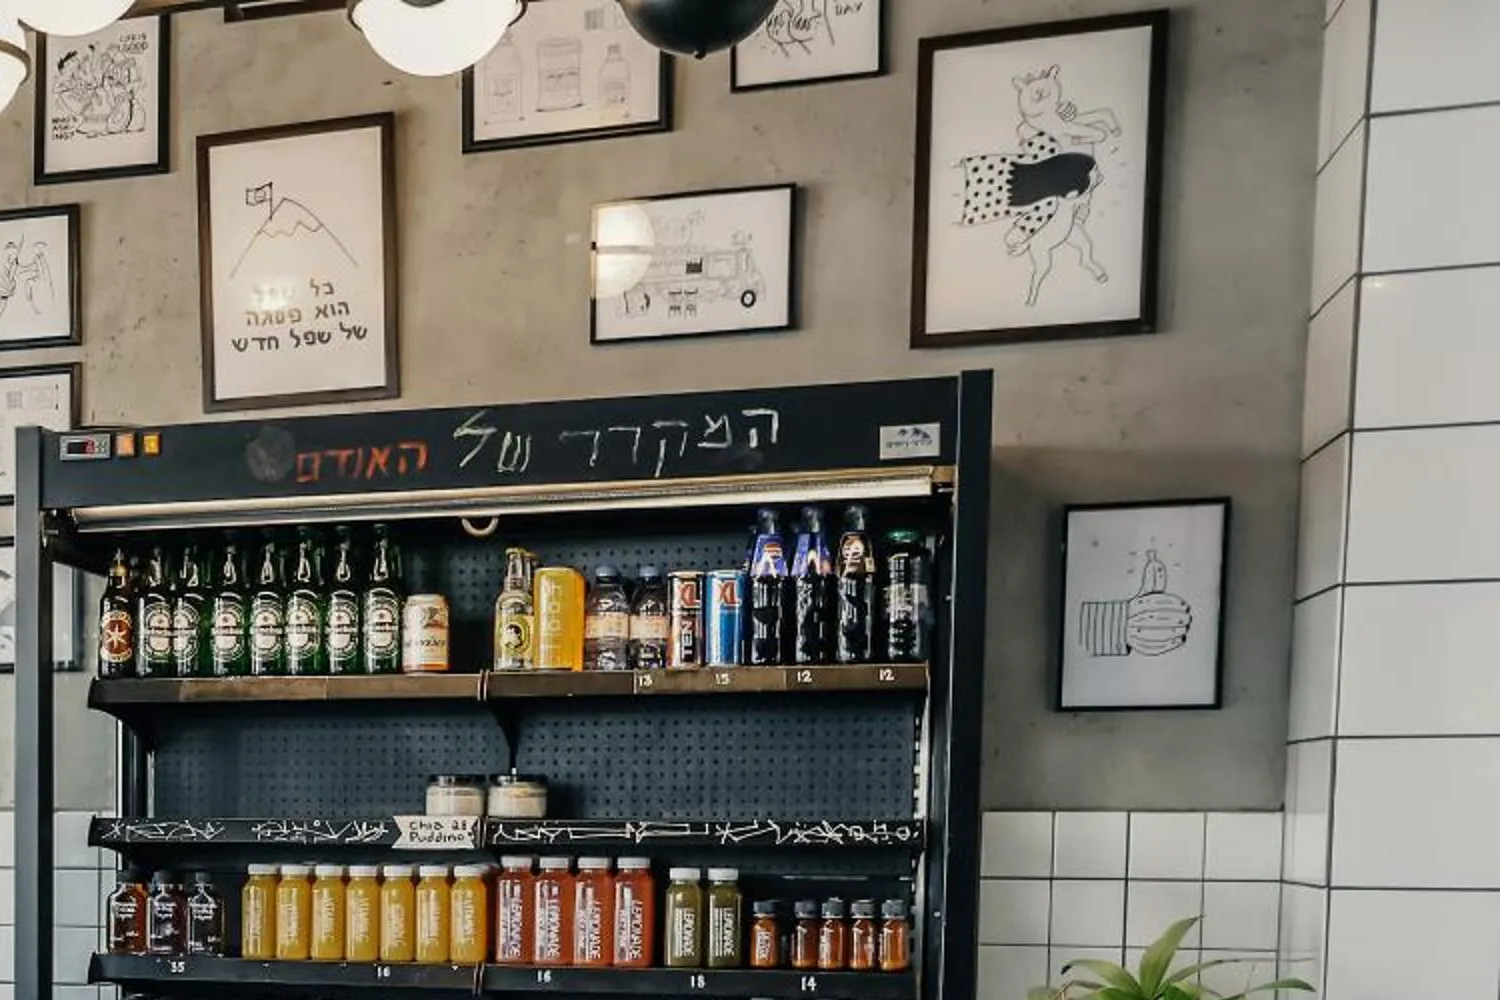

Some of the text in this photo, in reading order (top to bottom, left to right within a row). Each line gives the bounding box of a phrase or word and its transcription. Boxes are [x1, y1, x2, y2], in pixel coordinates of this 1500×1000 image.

[309, 278, 334, 297] כל
[244, 301, 350, 327] הוא פסגה
[231, 321, 368, 352] של שפל חדש
[295, 406, 780, 484] המקרר של האודם
[720, 580, 741, 608] XL
[797, 669, 813, 682] 12
[879, 668, 895, 681] 12
[409, 820, 444, 831] Chia
[589, 899, 601, 960] LEMONADE
[629, 899, 644, 960] LEMONADE
[801, 976, 817, 991] 14
